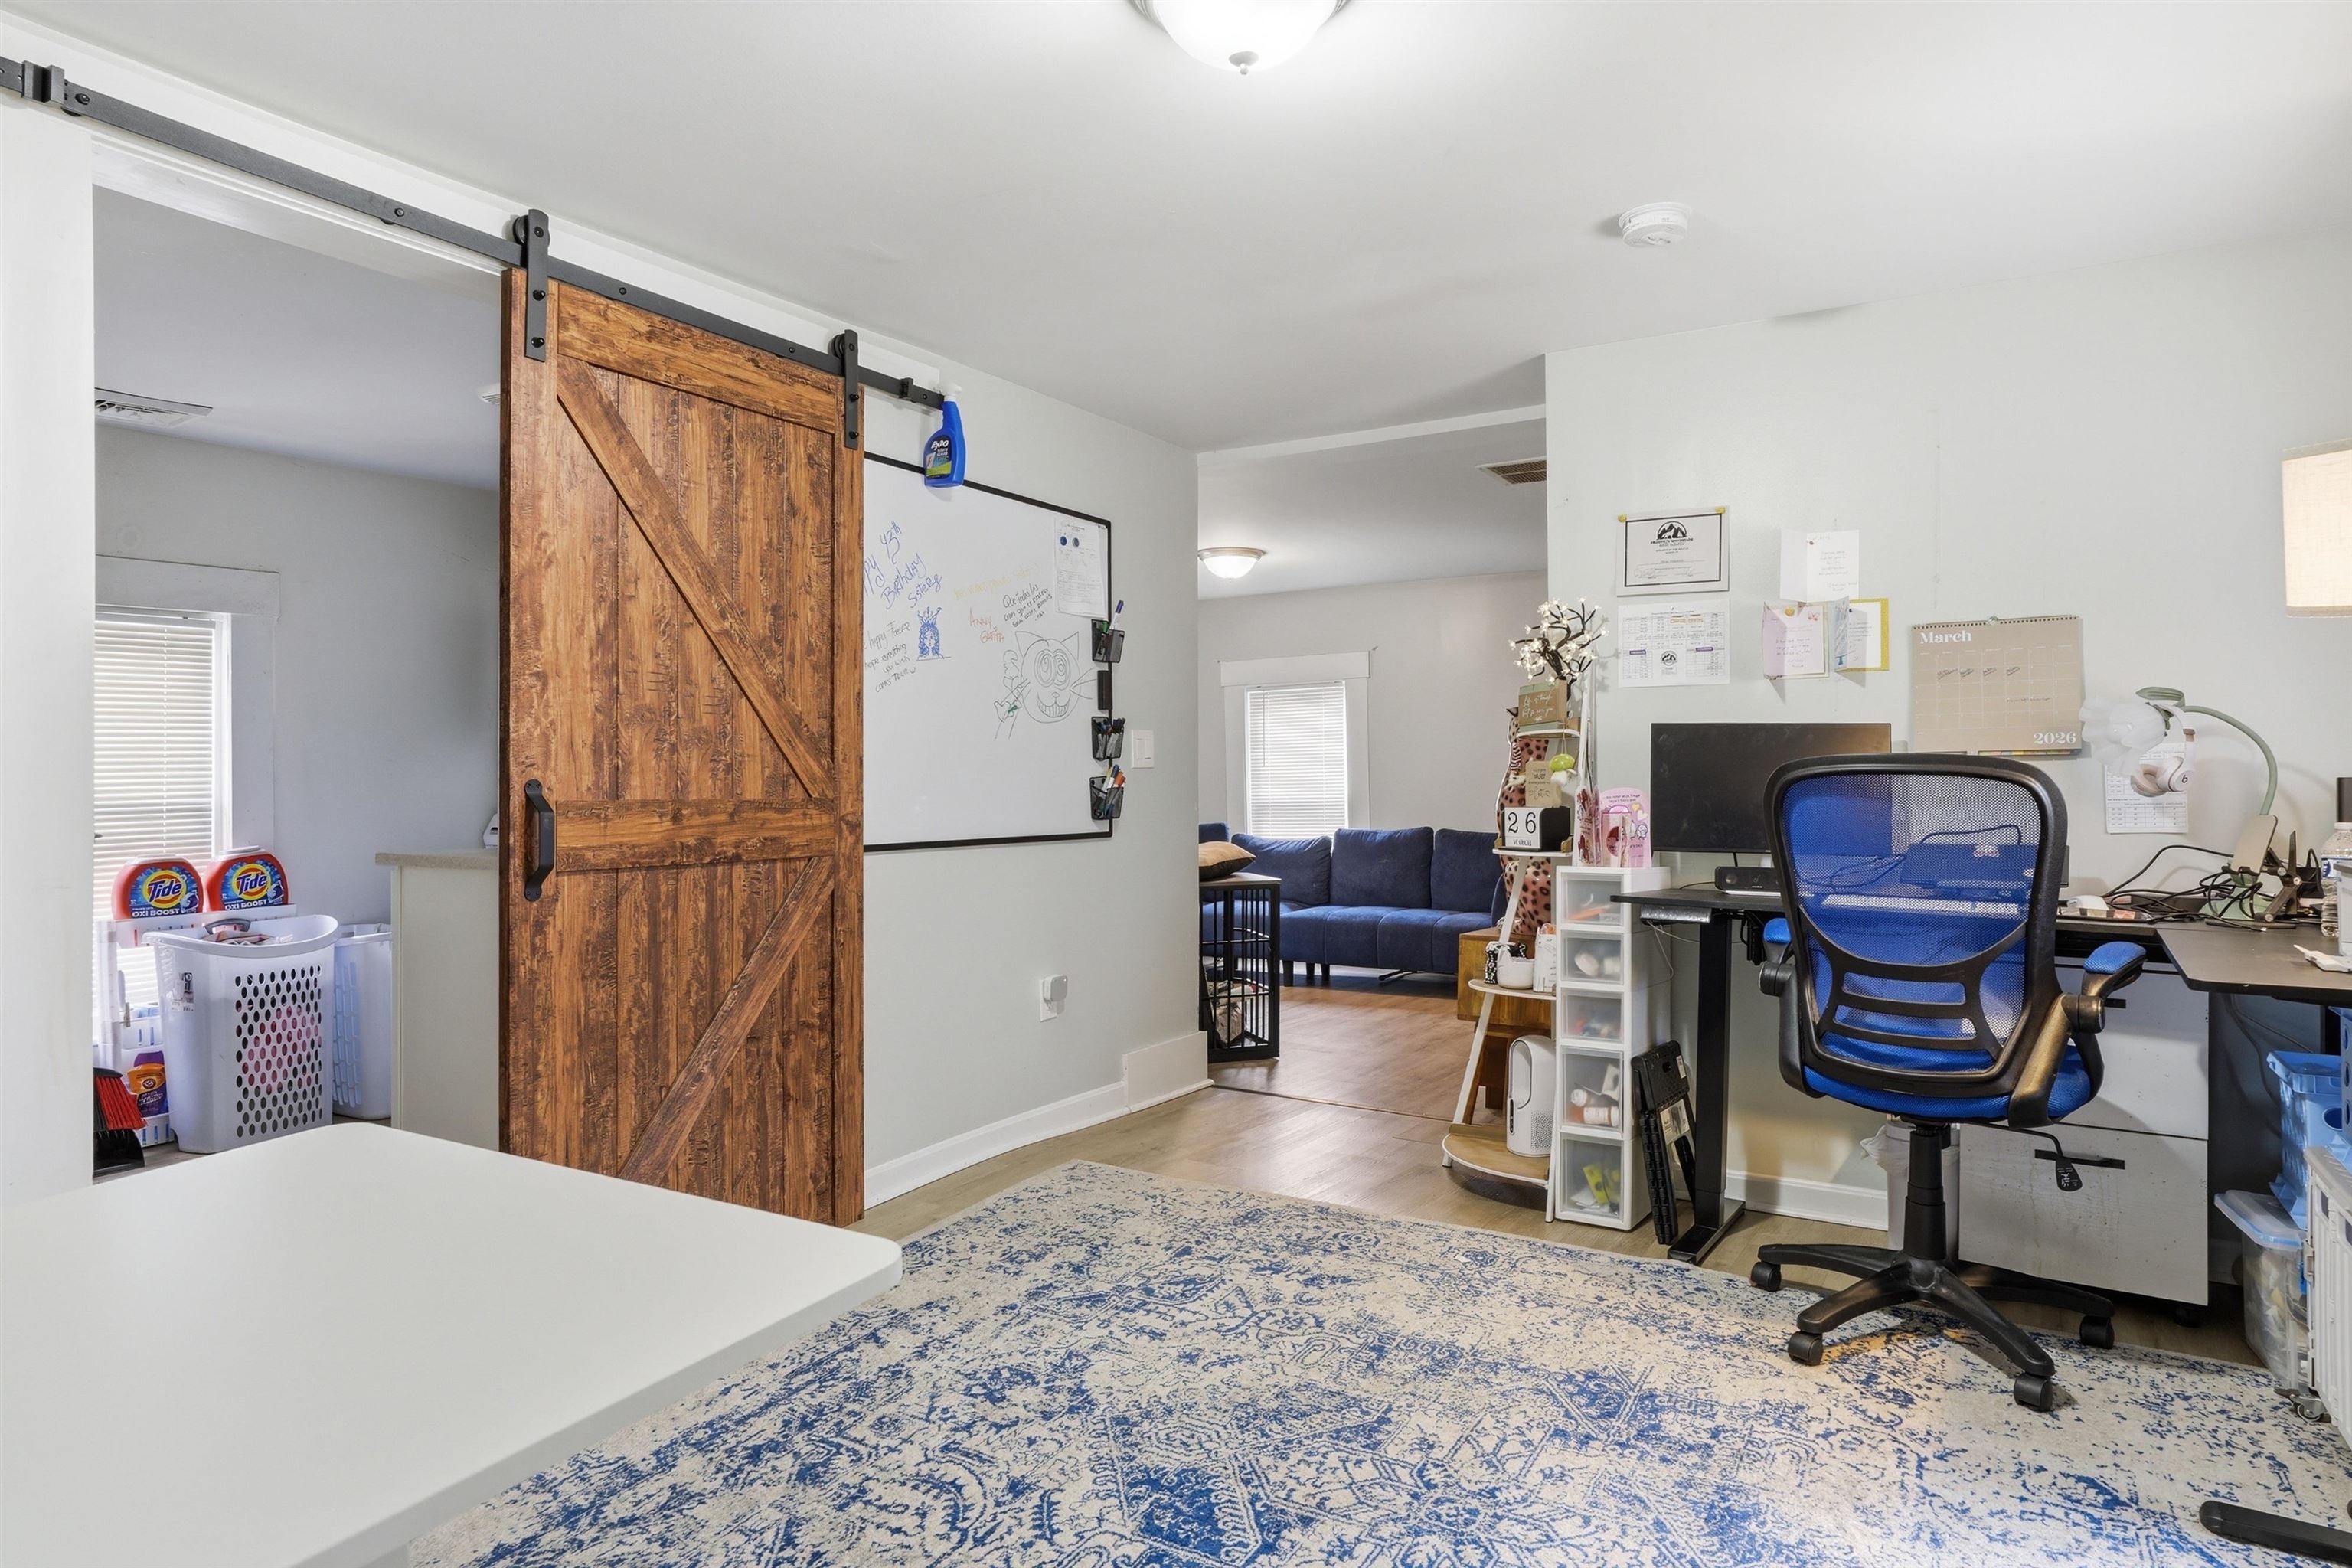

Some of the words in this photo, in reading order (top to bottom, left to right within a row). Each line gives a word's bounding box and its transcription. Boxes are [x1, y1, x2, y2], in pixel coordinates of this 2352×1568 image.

[931, 439, 949, 450] EXPO
[1919, 630, 1972, 644] March
[2033, 731, 2077, 745] 2026
[148, 878, 183, 903] Tide
[235, 873, 268, 896] Tide
[240, 899, 267, 909] BOOST
[150, 907, 179, 916] BOOST
